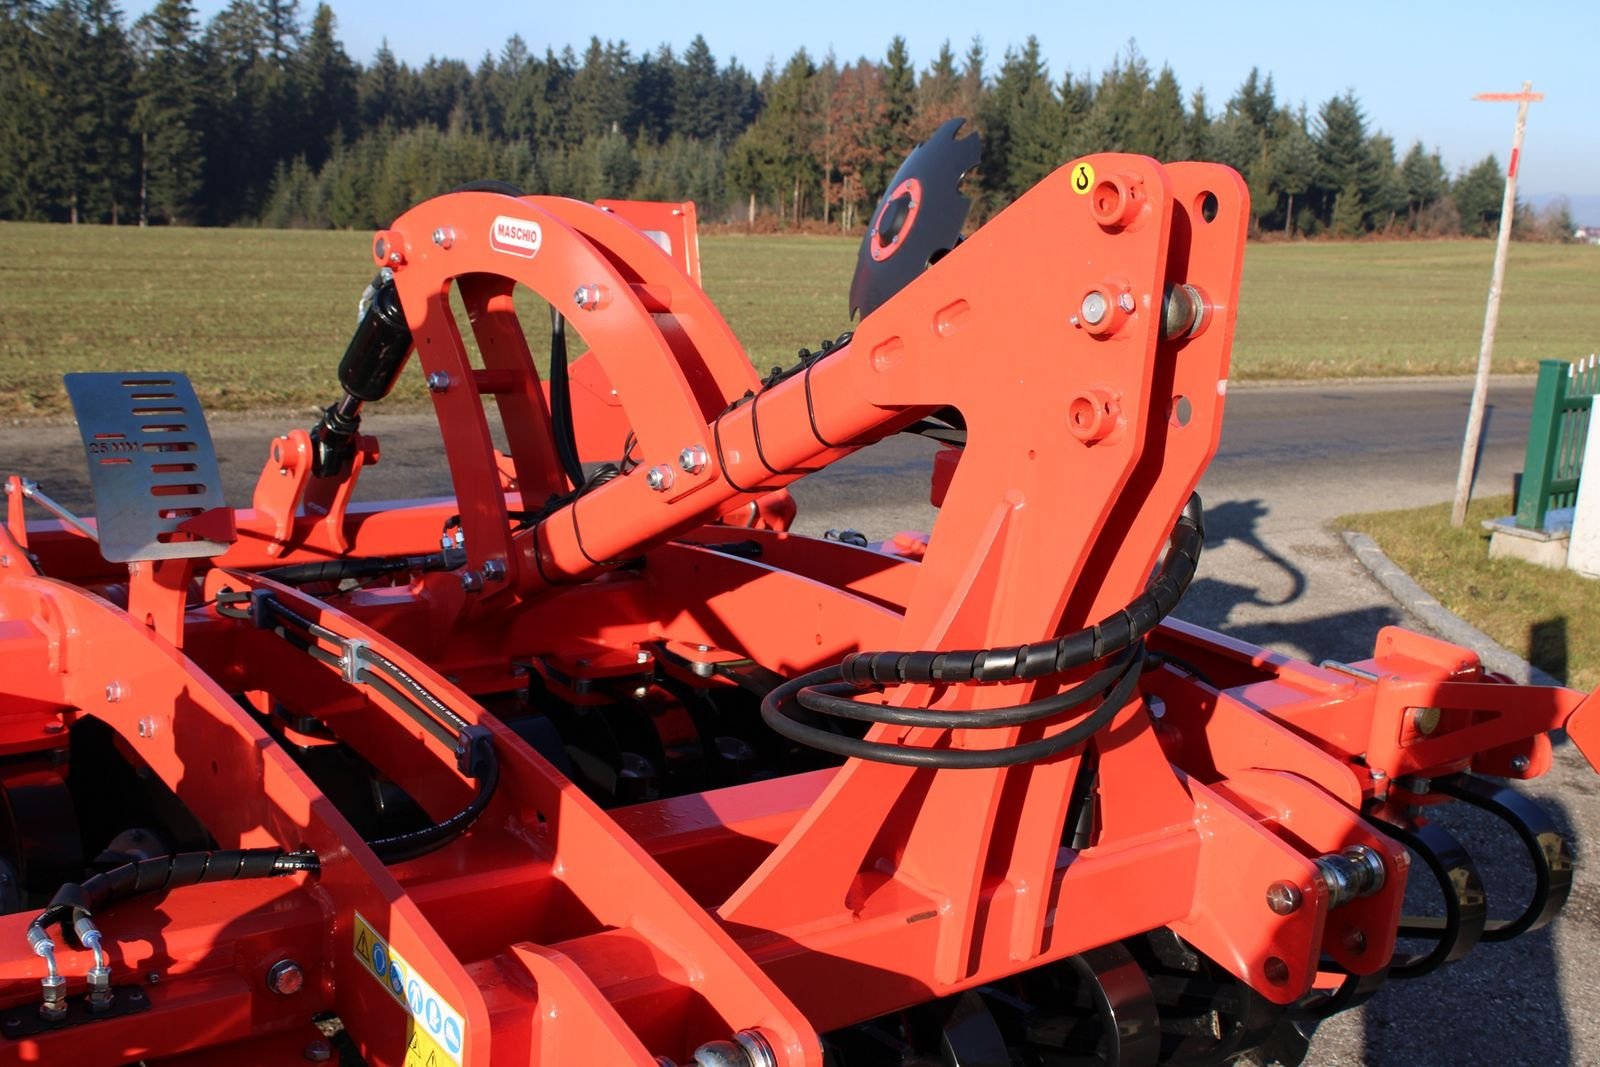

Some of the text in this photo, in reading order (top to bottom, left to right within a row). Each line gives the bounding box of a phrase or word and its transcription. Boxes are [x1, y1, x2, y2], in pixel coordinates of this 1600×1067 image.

[498, 224, 537, 243] MASCHIO
[90, 441, 141, 454] 25 MM
